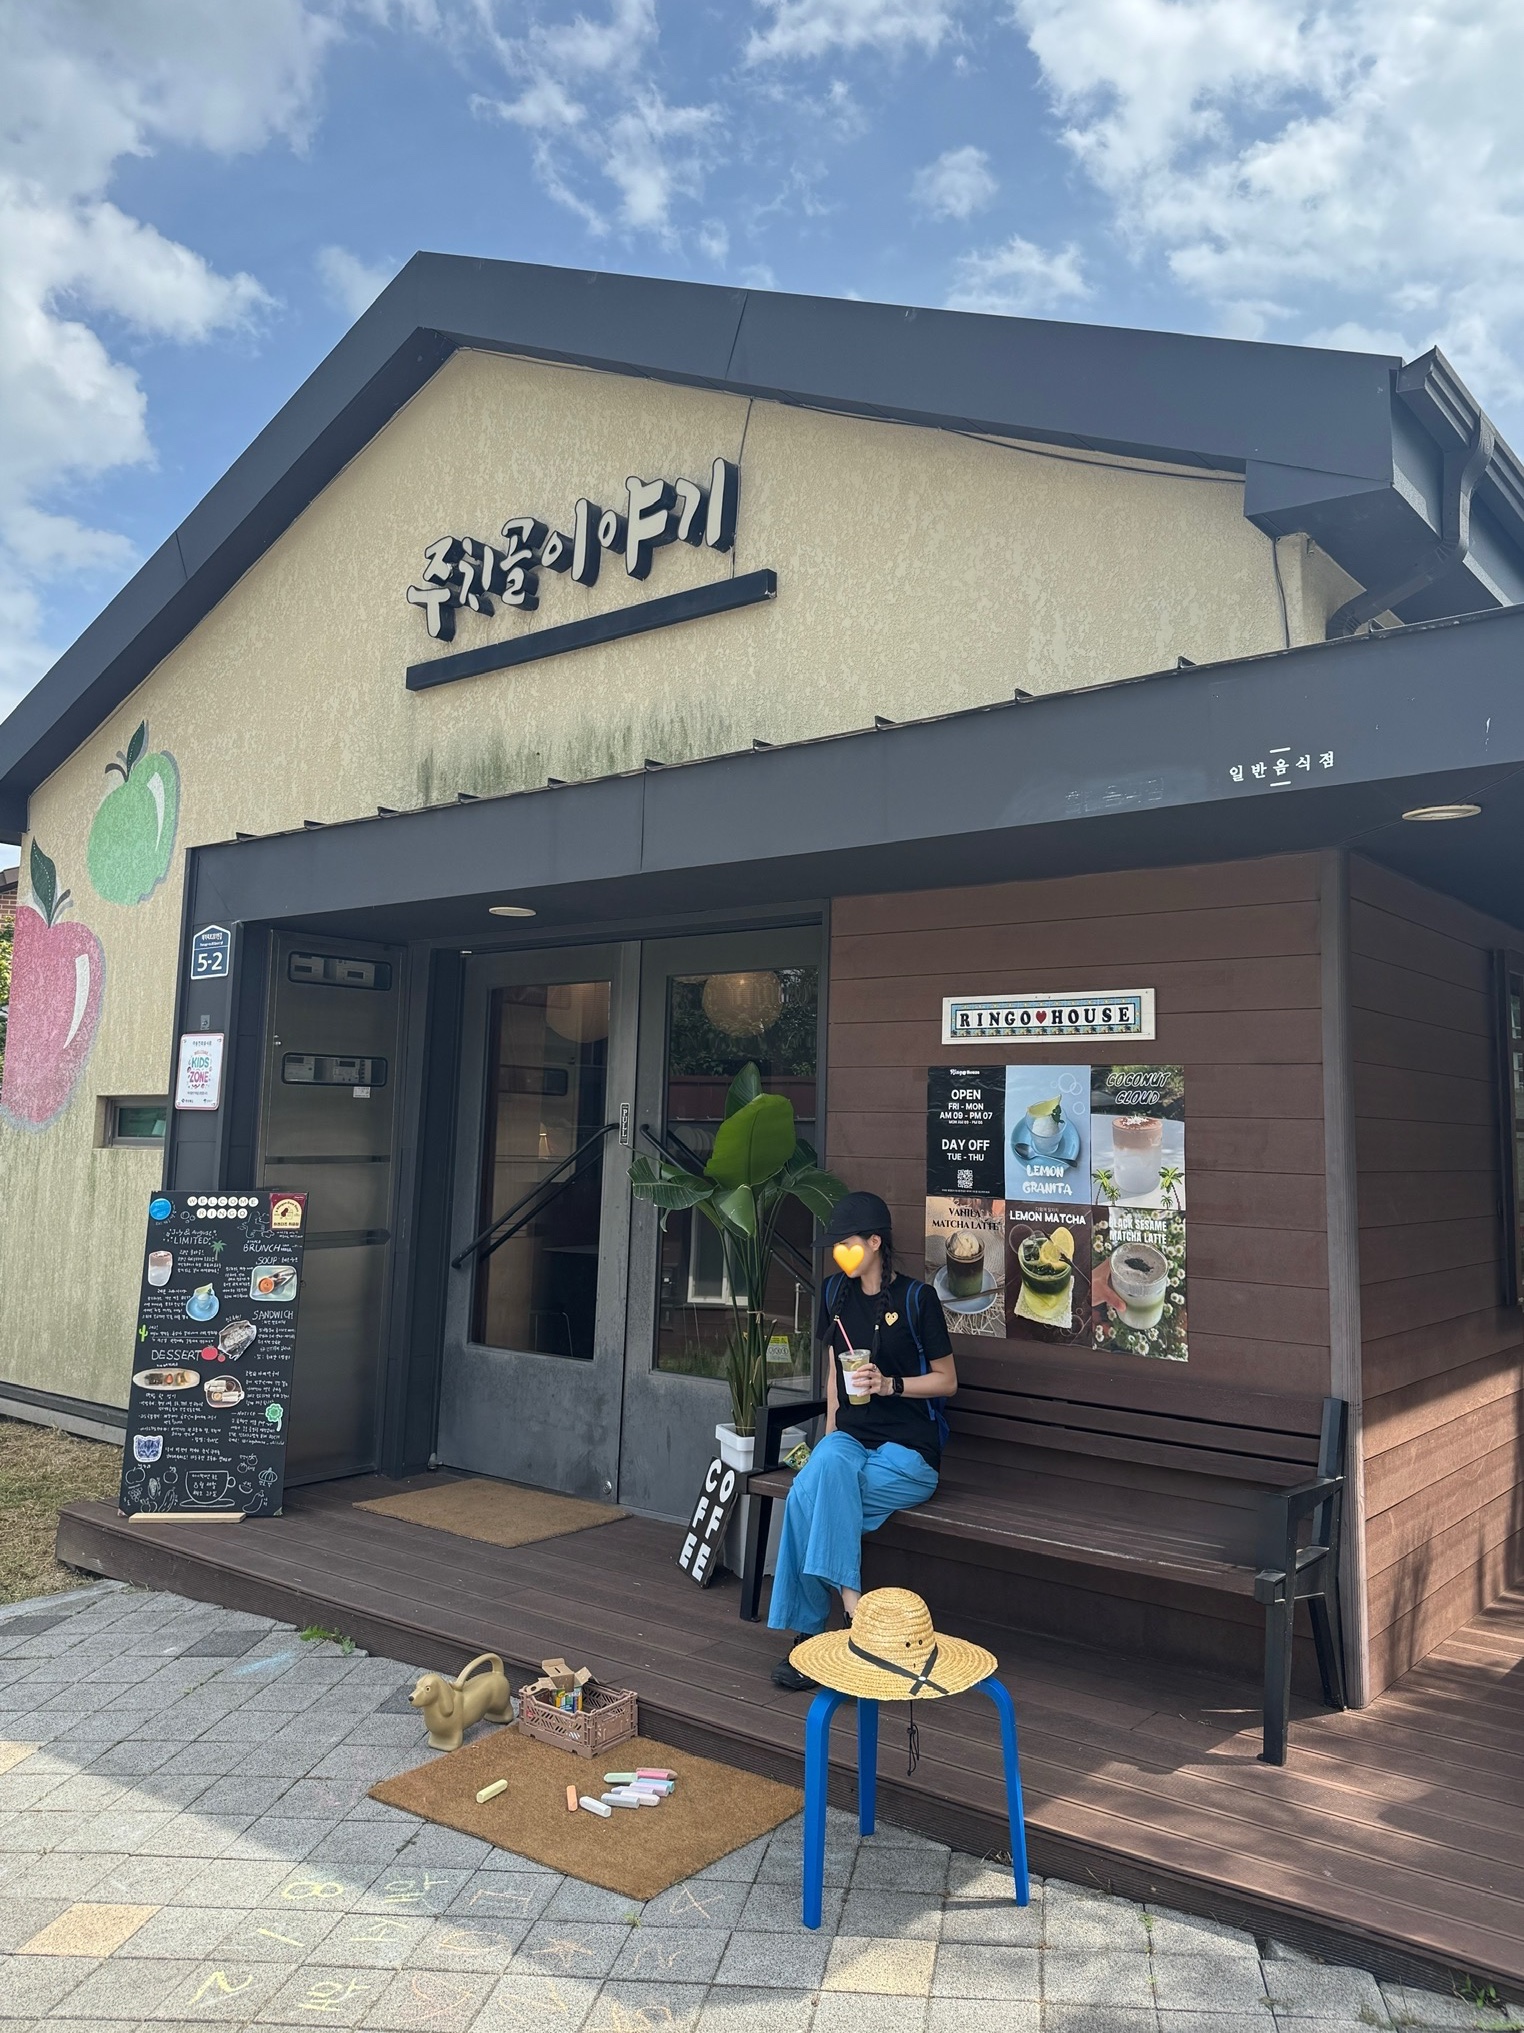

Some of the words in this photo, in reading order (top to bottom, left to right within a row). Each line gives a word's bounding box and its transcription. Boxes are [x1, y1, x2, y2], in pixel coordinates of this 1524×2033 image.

[1229, 750, 1334, 783] 일반음식점
[197, 952, 223, 972] 5-2
[959, 1009, 1031, 1028] RINGO
[1051, 1006, 1130, 1025] HOUSE
[191, 1056, 210, 1068] KIDS
[189, 1070, 209, 1083] ZONE
[1106, 1071, 1171, 1088] COCONUT
[951, 1089, 981, 1100] OPEN
[1115, 1090, 1160, 1105] CLOUD
[948, 1102, 959, 1110] FRI
[965, 1102, 984, 1110] MON
[982, 1112, 993, 1120] 07
[941, 1139, 966, 1150] DAY
[968, 1140, 990, 1151] OFF
[947, 1153, 962, 1161] TUE
[968, 1153, 985, 1161] THU
[1026, 1164, 1065, 1178] LEMON
[1022, 1181, 1073, 1196] GRANITA
[188, 1196, 259, 1207] WELCOME
[197, 1208, 248, 1219] RINGO
[1009, 1210, 1042, 1222] LEMON
[1044, 1212, 1087, 1225] MATCHA
[932, 1219, 970, 1229] MATCHA
[971, 1220, 999, 1231] LATTE
[1109, 1217, 1134, 1230] BLACK
[1135, 1219, 1168, 1232] SESAME
[173, 1237, 210, 1245] LIMITED
[1109, 1230, 1142, 1243] MATCHA
[1143, 1232, 1168, 1245] LATTE
[243, 1244, 281, 1253] BRUNCH
[257, 1256, 278, 1265] SOUP
[252, 1310, 294, 1321] SANDWICH
[151, 1349, 203, 1362] DESSERT
